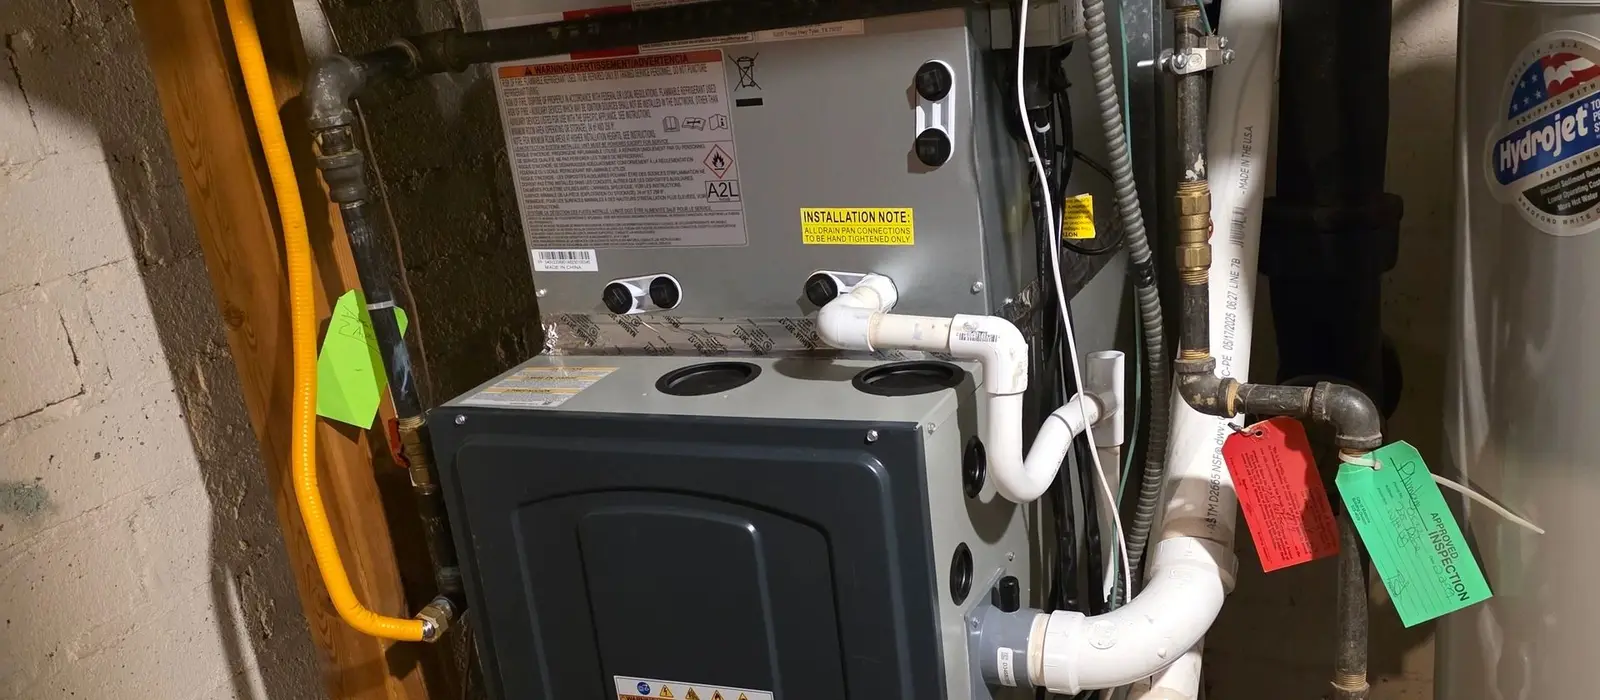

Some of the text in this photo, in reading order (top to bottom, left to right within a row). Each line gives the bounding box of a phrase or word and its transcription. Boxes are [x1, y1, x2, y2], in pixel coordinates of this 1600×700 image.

[1516, 83, 1596, 125] EQUIPPED WITH
[1241, 144, 1252, 158] THE
[1240, 158, 1250, 168] IN
[1238, 169, 1250, 190] MADE
[1561, 173, 1586, 188] Sediment
[708, 182, 739, 198] A2L
[1548, 194, 1562, 205] Lower
[1562, 184, 1589, 198] Operating
[1518, 196, 1556, 224] BRADFORD
[1563, 214, 1591, 224] WHITE
[1558, 192, 1598, 212] More Hot Water
[804, 211, 910, 223] INSTALLATION NOTE:
[804, 234, 910, 243] TO BE HAND TIGHTENED ONLY
[856, 227, 911, 235] CONNECTIONS
[1231, 258, 1240, 268] 7B
[1229, 270, 1240, 289] LINE
[1222, 312, 1236, 350] 05/17/2025
[1221, 355, 1233, 379] C-PE
[1208, 473, 1220, 502] D2665
[1206, 504, 1217, 530] ASTM
[1429, 511, 1460, 559] APPROVED
[1426, 530, 1470, 601] INSPECTION
